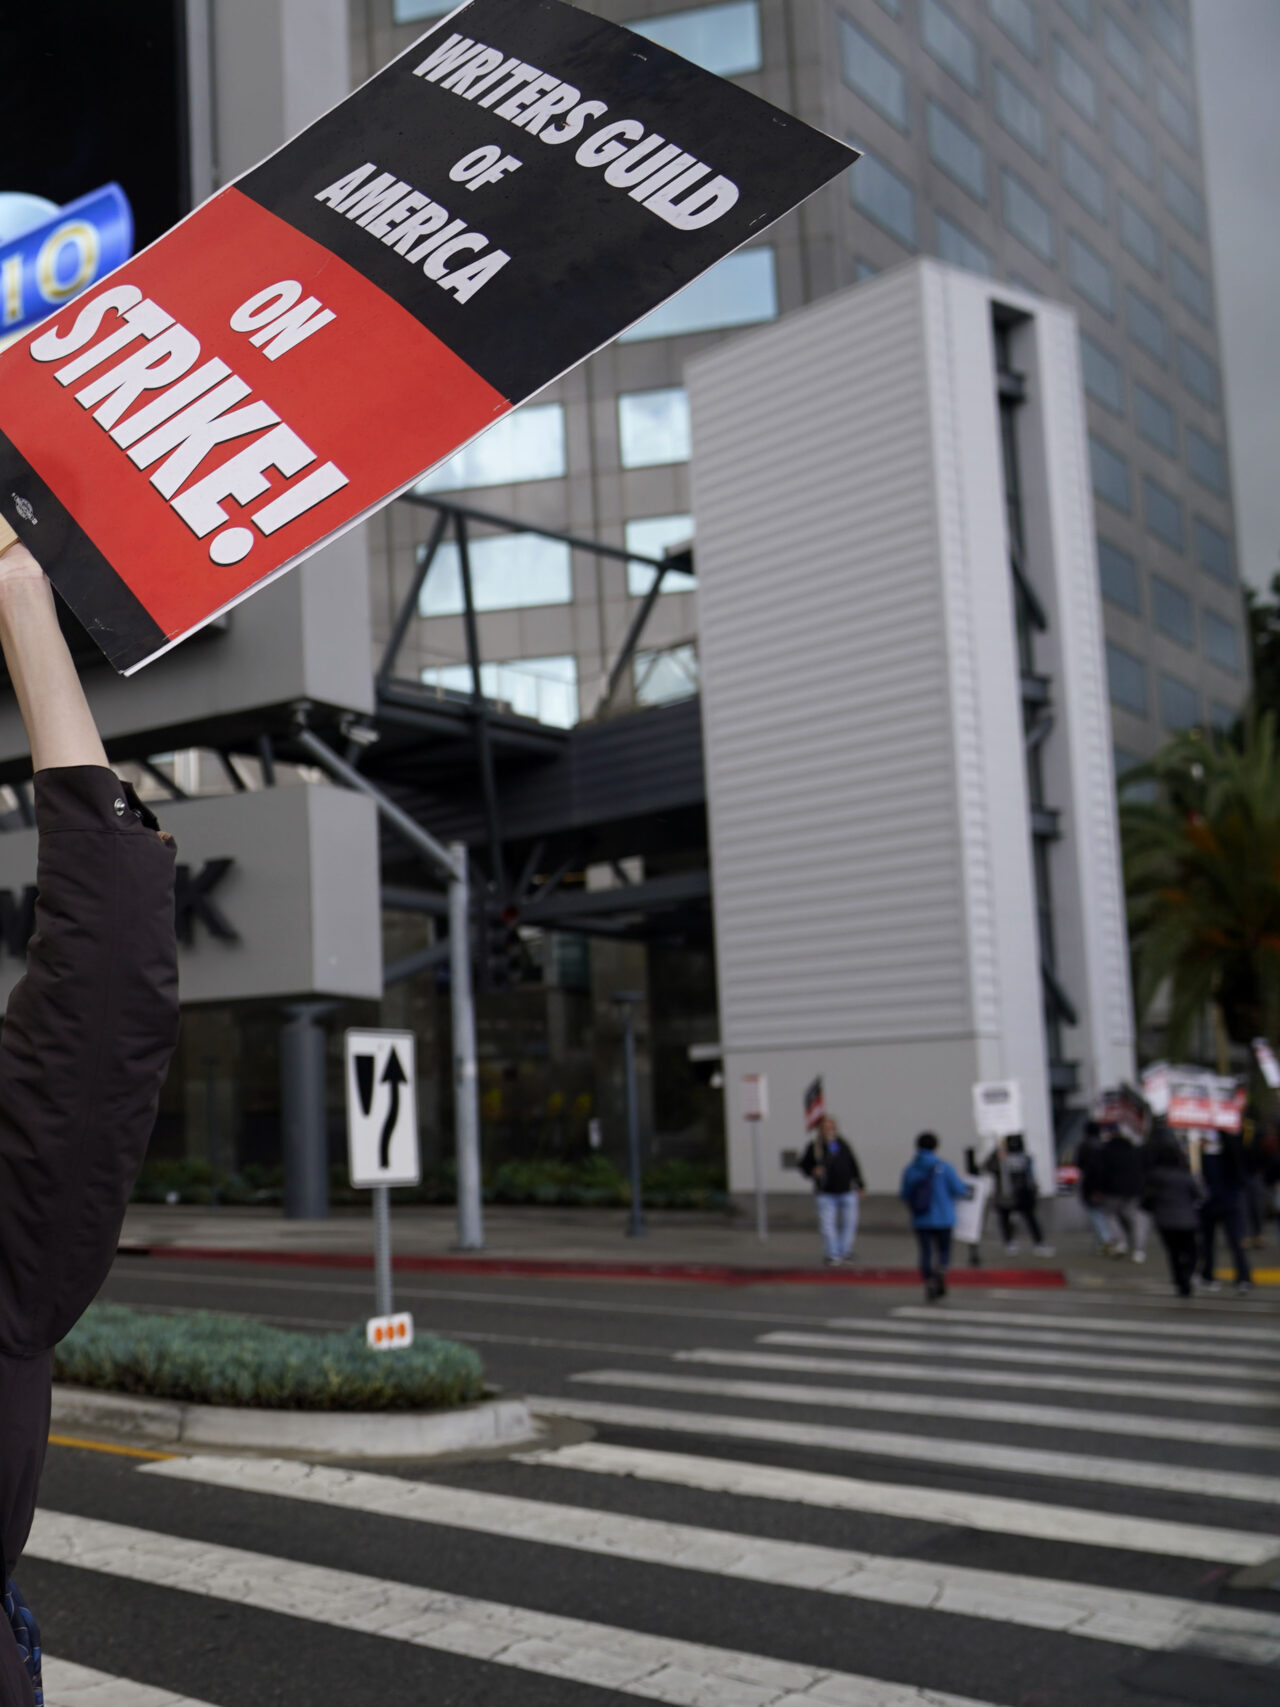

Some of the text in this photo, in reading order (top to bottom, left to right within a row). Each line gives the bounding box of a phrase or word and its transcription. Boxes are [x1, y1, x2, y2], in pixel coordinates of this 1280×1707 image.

[412, 33, 740, 231] WRITERS GUILD
[448, 144, 523, 192] OF
[314, 162, 512, 305] AMERICA
[229, 279, 338, 362] ON
[29, 284, 351, 568] STRIKE!
